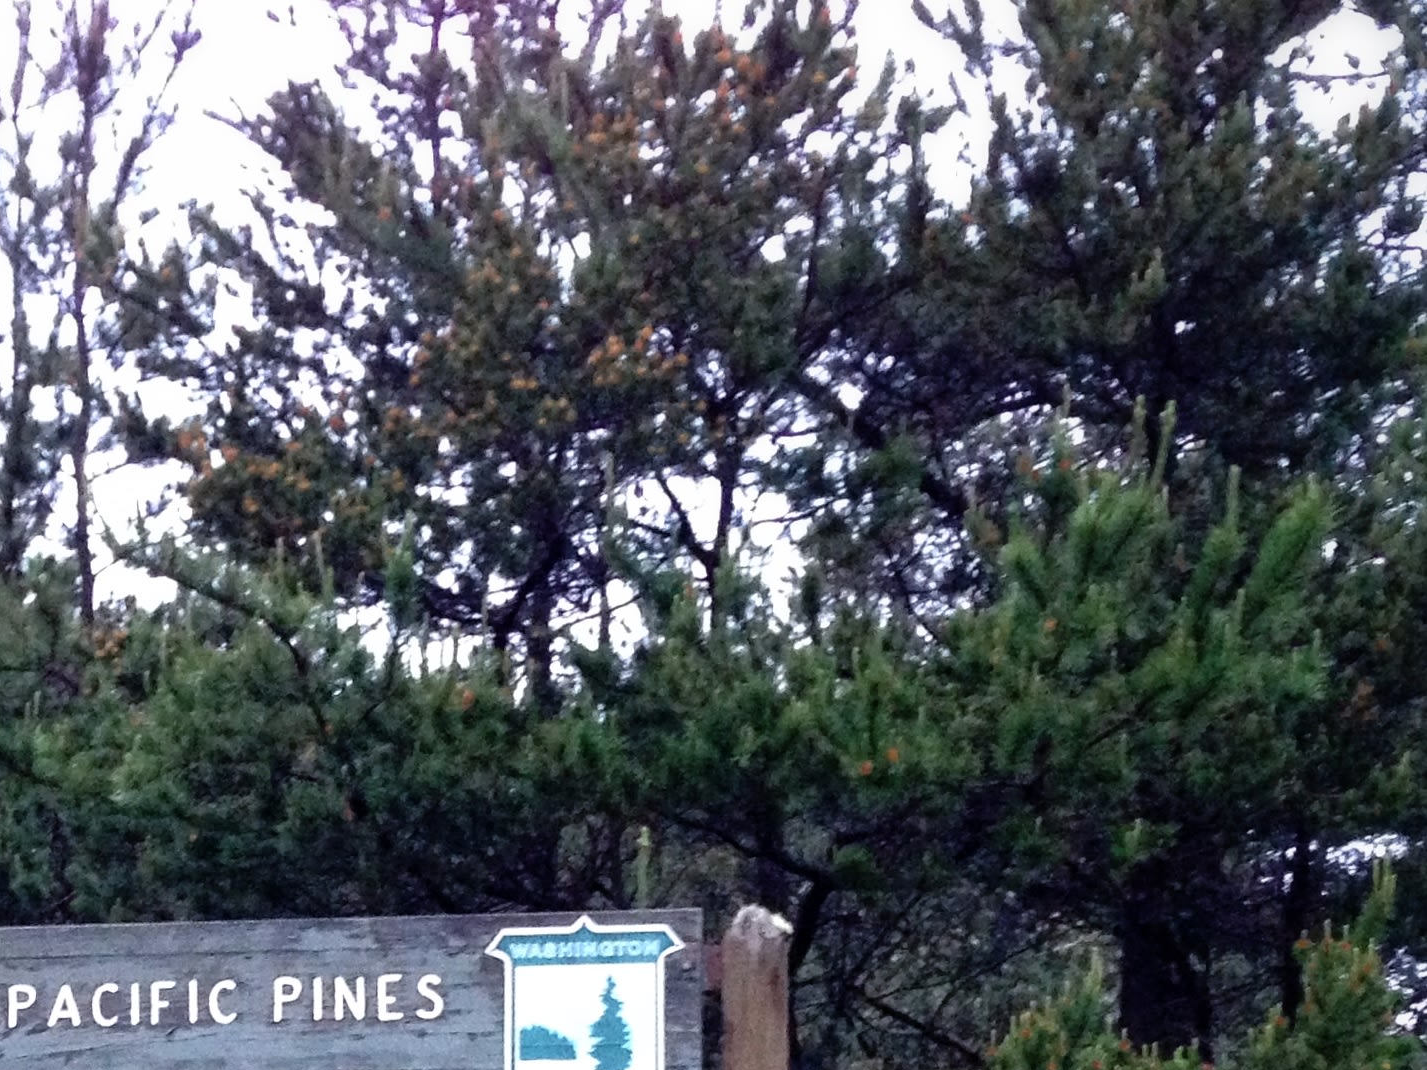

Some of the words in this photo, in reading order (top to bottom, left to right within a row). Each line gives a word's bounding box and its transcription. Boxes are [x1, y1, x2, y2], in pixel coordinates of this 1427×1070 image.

[508, 939, 661, 959] WASHINGTON
[7, 979, 238, 1028] PACIFIC
[273, 973, 445, 1023] PINES
